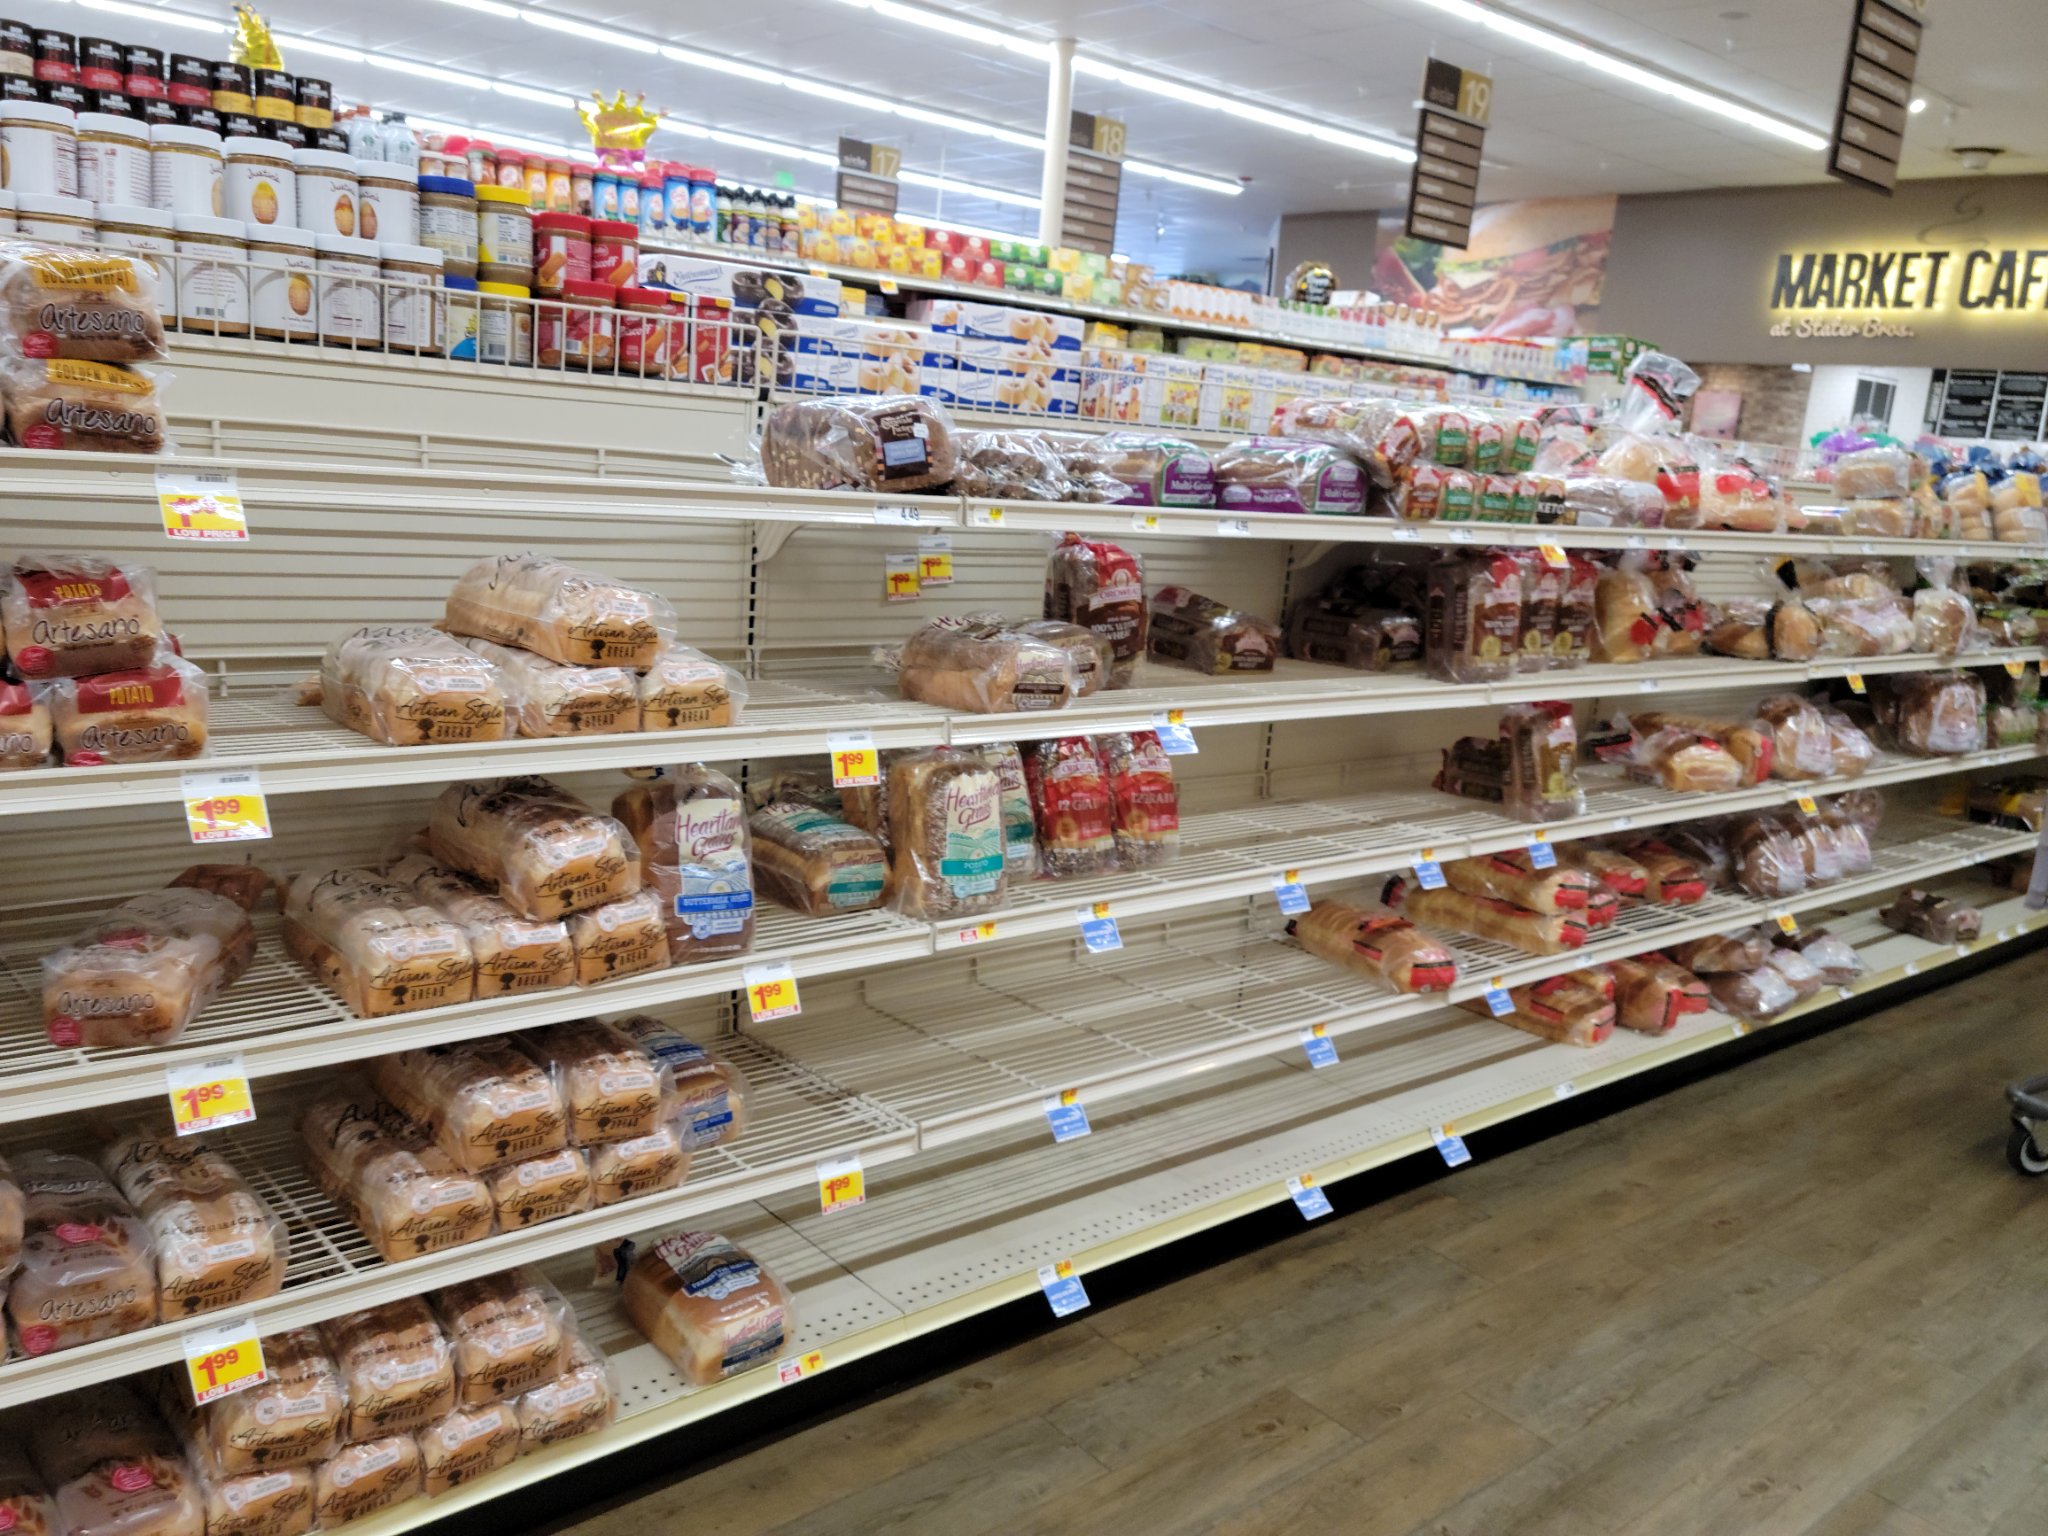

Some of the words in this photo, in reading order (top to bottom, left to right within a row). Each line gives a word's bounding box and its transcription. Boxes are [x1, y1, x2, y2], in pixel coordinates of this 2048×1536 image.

[1466, 79, 1490, 120] 19
[1099, 125, 1124, 157] 18
[876, 152, 899, 178] 17
[43, 268, 84, 284] GOLDEN
[1770, 251, 1950, 309] MARKET
[1958, 250, 2048, 309] CAF
[1770, 321, 1791, 338] at
[1796, 316, 1860, 339] Stater
[1537, 502, 1565, 515] KETO
[54, 583, 102, 600] POTATO
[568, 616, 627, 640] Artisan
[605, 645, 637, 659] BREAD
[109, 684, 154, 705] POTATO
[395, 694, 461, 718] Artisan
[838, 753, 864, 777] 199
[196, 799, 240, 829] 199
[675, 808, 741, 844] Heartlan
[535, 869, 592, 897] Artisan
[370, 961, 433, 985] Artisan
[478, 951, 539, 974] Artisan
[755, 983, 782, 1010] 199
[181, 1084, 225, 1119] 199
[575, 1100, 631, 1120] Artisan
[471, 1121, 531, 1145] Artisan
[499, 1191, 554, 1213] Artisan
[826, 1177, 850, 1203] 199
[390, 1214, 452, 1238] Artisan
[163, 1276, 231, 1298] Artisan
[198, 1349, 239, 1387] 199
[469, 1362, 528, 1382] Artisan
[202, 1384, 226, 1399] LOW
[229, 1372, 260, 1391] PRICE
[230, 1428, 295, 1451] Artisan
